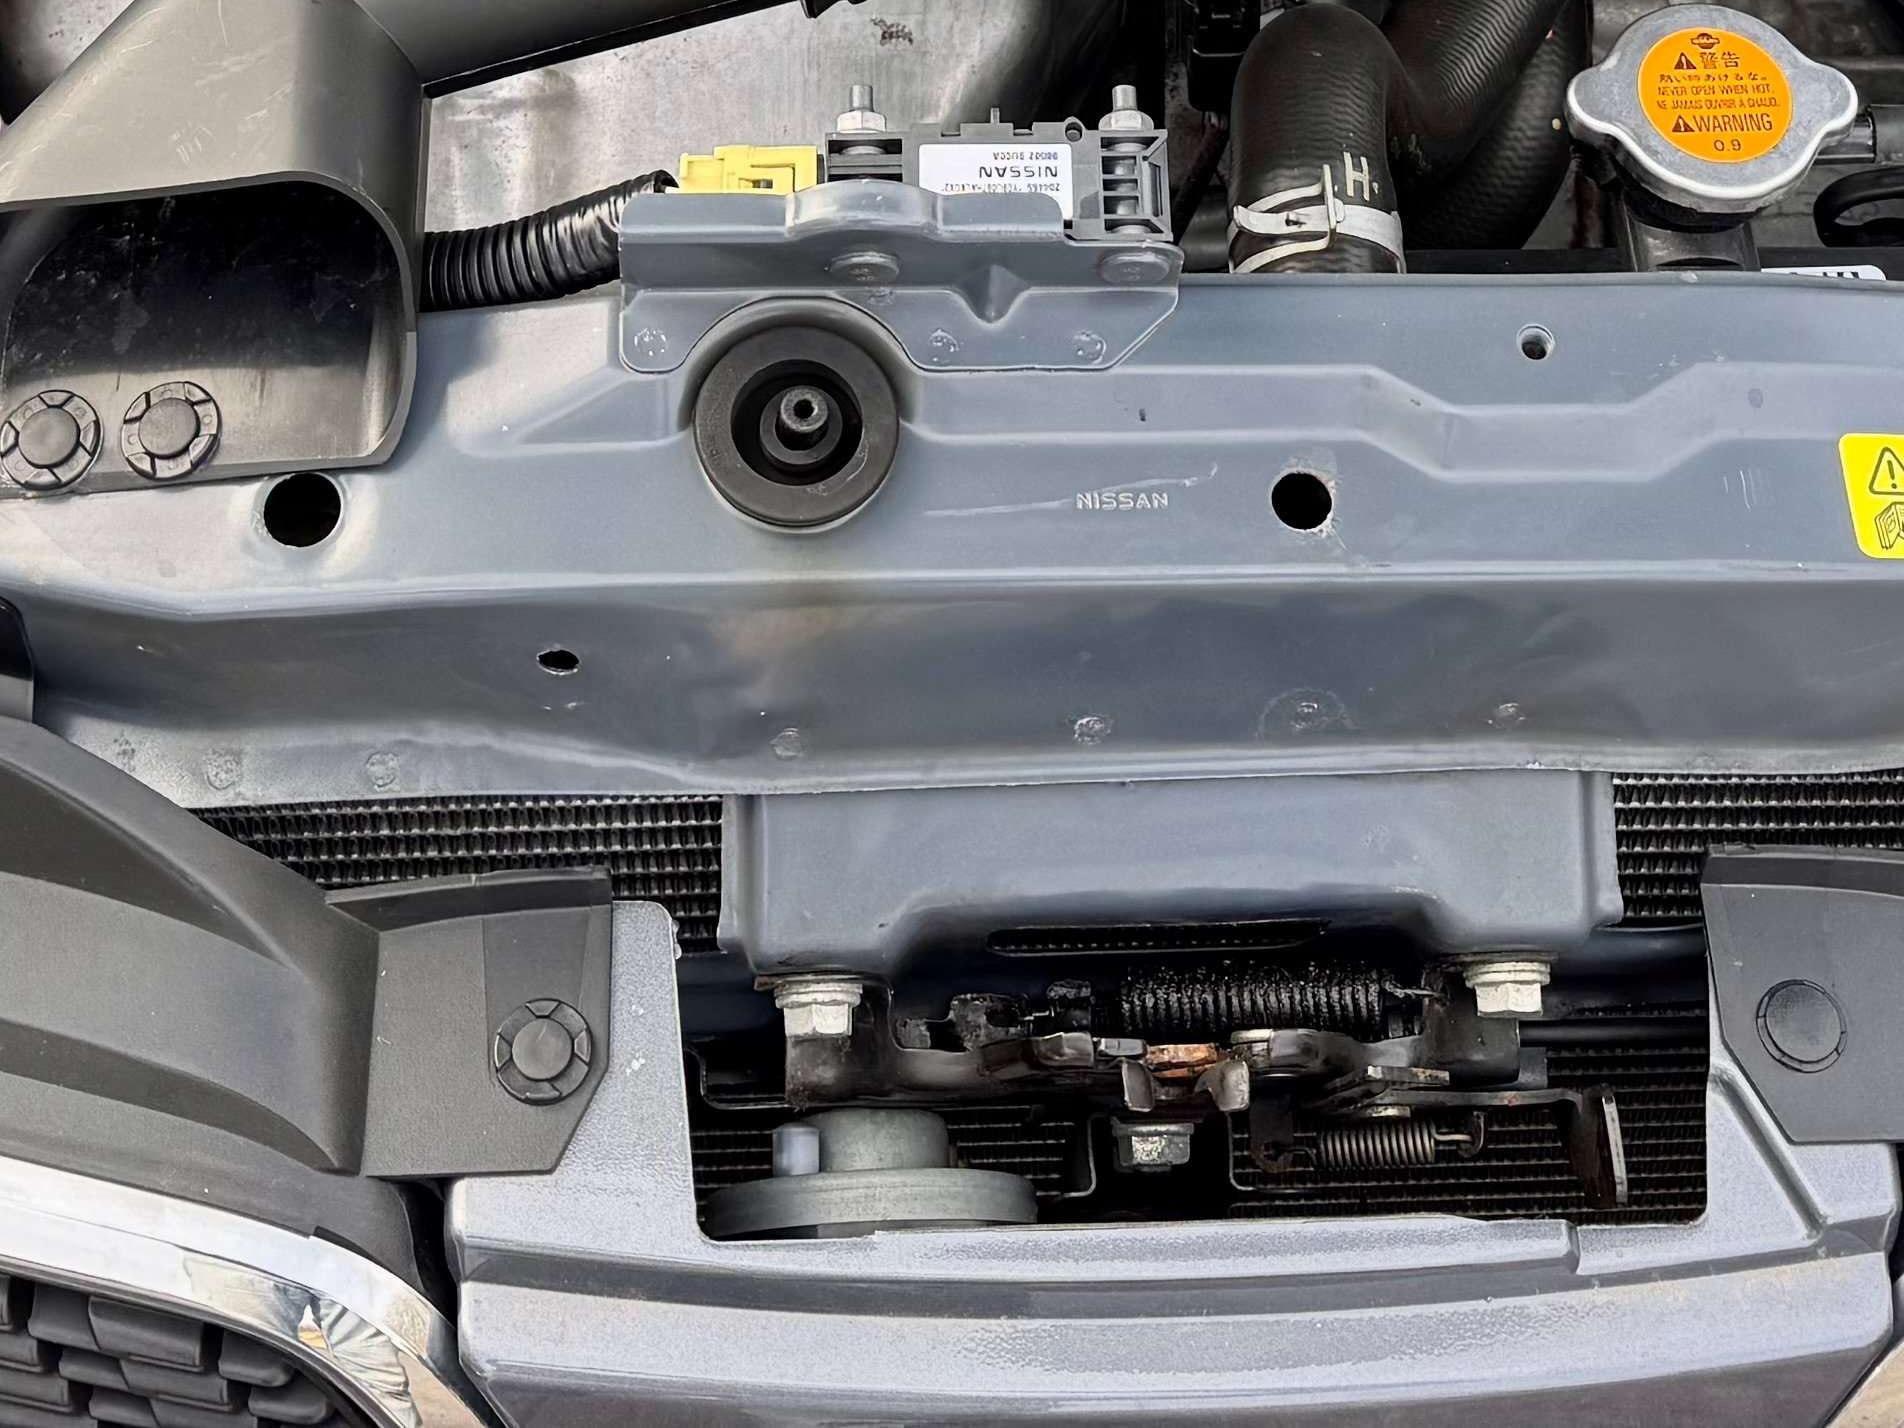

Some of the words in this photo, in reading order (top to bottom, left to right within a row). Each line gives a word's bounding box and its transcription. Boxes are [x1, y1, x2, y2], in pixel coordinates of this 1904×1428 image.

[1699, 50, 1741, 71] 警告
[1658, 85, 1688, 97] NEVER
[1691, 85, 1716, 97] OPEN
[1720, 83, 1749, 96] WHEN
[1692, 112, 1774, 133] WARNING
[1713, 138, 1742, 152] 0.9
[979, 165, 1058, 179] NISSAN
[1076, 491, 1169, 511] NISSAN
